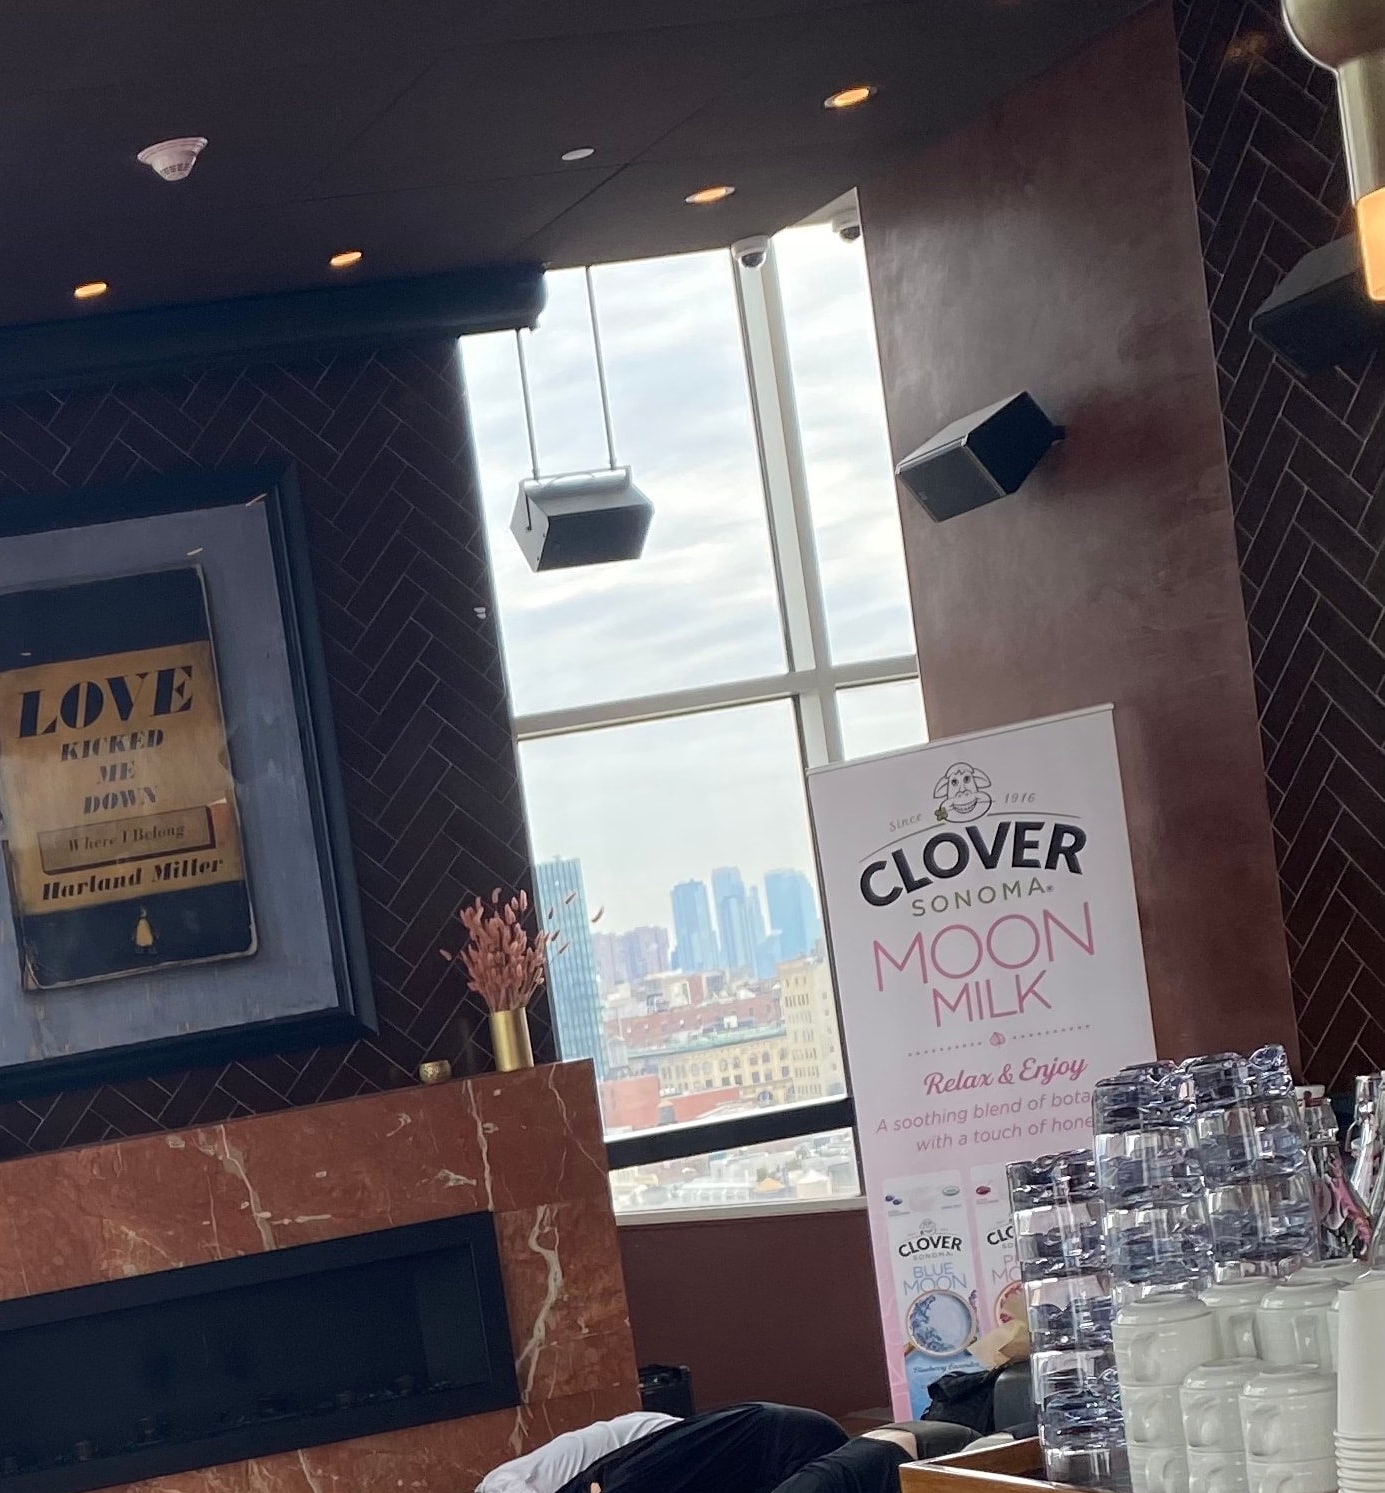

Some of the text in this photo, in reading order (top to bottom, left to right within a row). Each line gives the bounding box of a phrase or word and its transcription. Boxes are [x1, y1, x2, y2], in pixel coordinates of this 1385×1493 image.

[17, 665, 193, 739] LOVE
[61, 729, 164, 761] KICKED
[96, 761, 136, 784] ME
[83, 785, 158, 815] DOWN
[889, 792, 1036, 832] Since 1916
[68, 825, 185, 852] Where I Belong
[42, 858, 223, 900] Harland Miller
[859, 821, 1087, 907] CLOVER
[911, 877, 1046, 917] SONOMA
[873, 902, 1095, 992] MOON
[933, 969, 1052, 1028] MILK
[923, 1056, 1088, 1095] Relax & Enjoy
[876, 1090, 1092, 1134] A soothing blend of bota
[916, 1115, 1094, 1151] with a touch of hone
[898, 1235, 962, 1257] CLOVER
[986, 1226, 1014, 1246] CLO
[903, 1273, 968, 1296] MOON
[912, 1262, 954, 1279] BLUE
